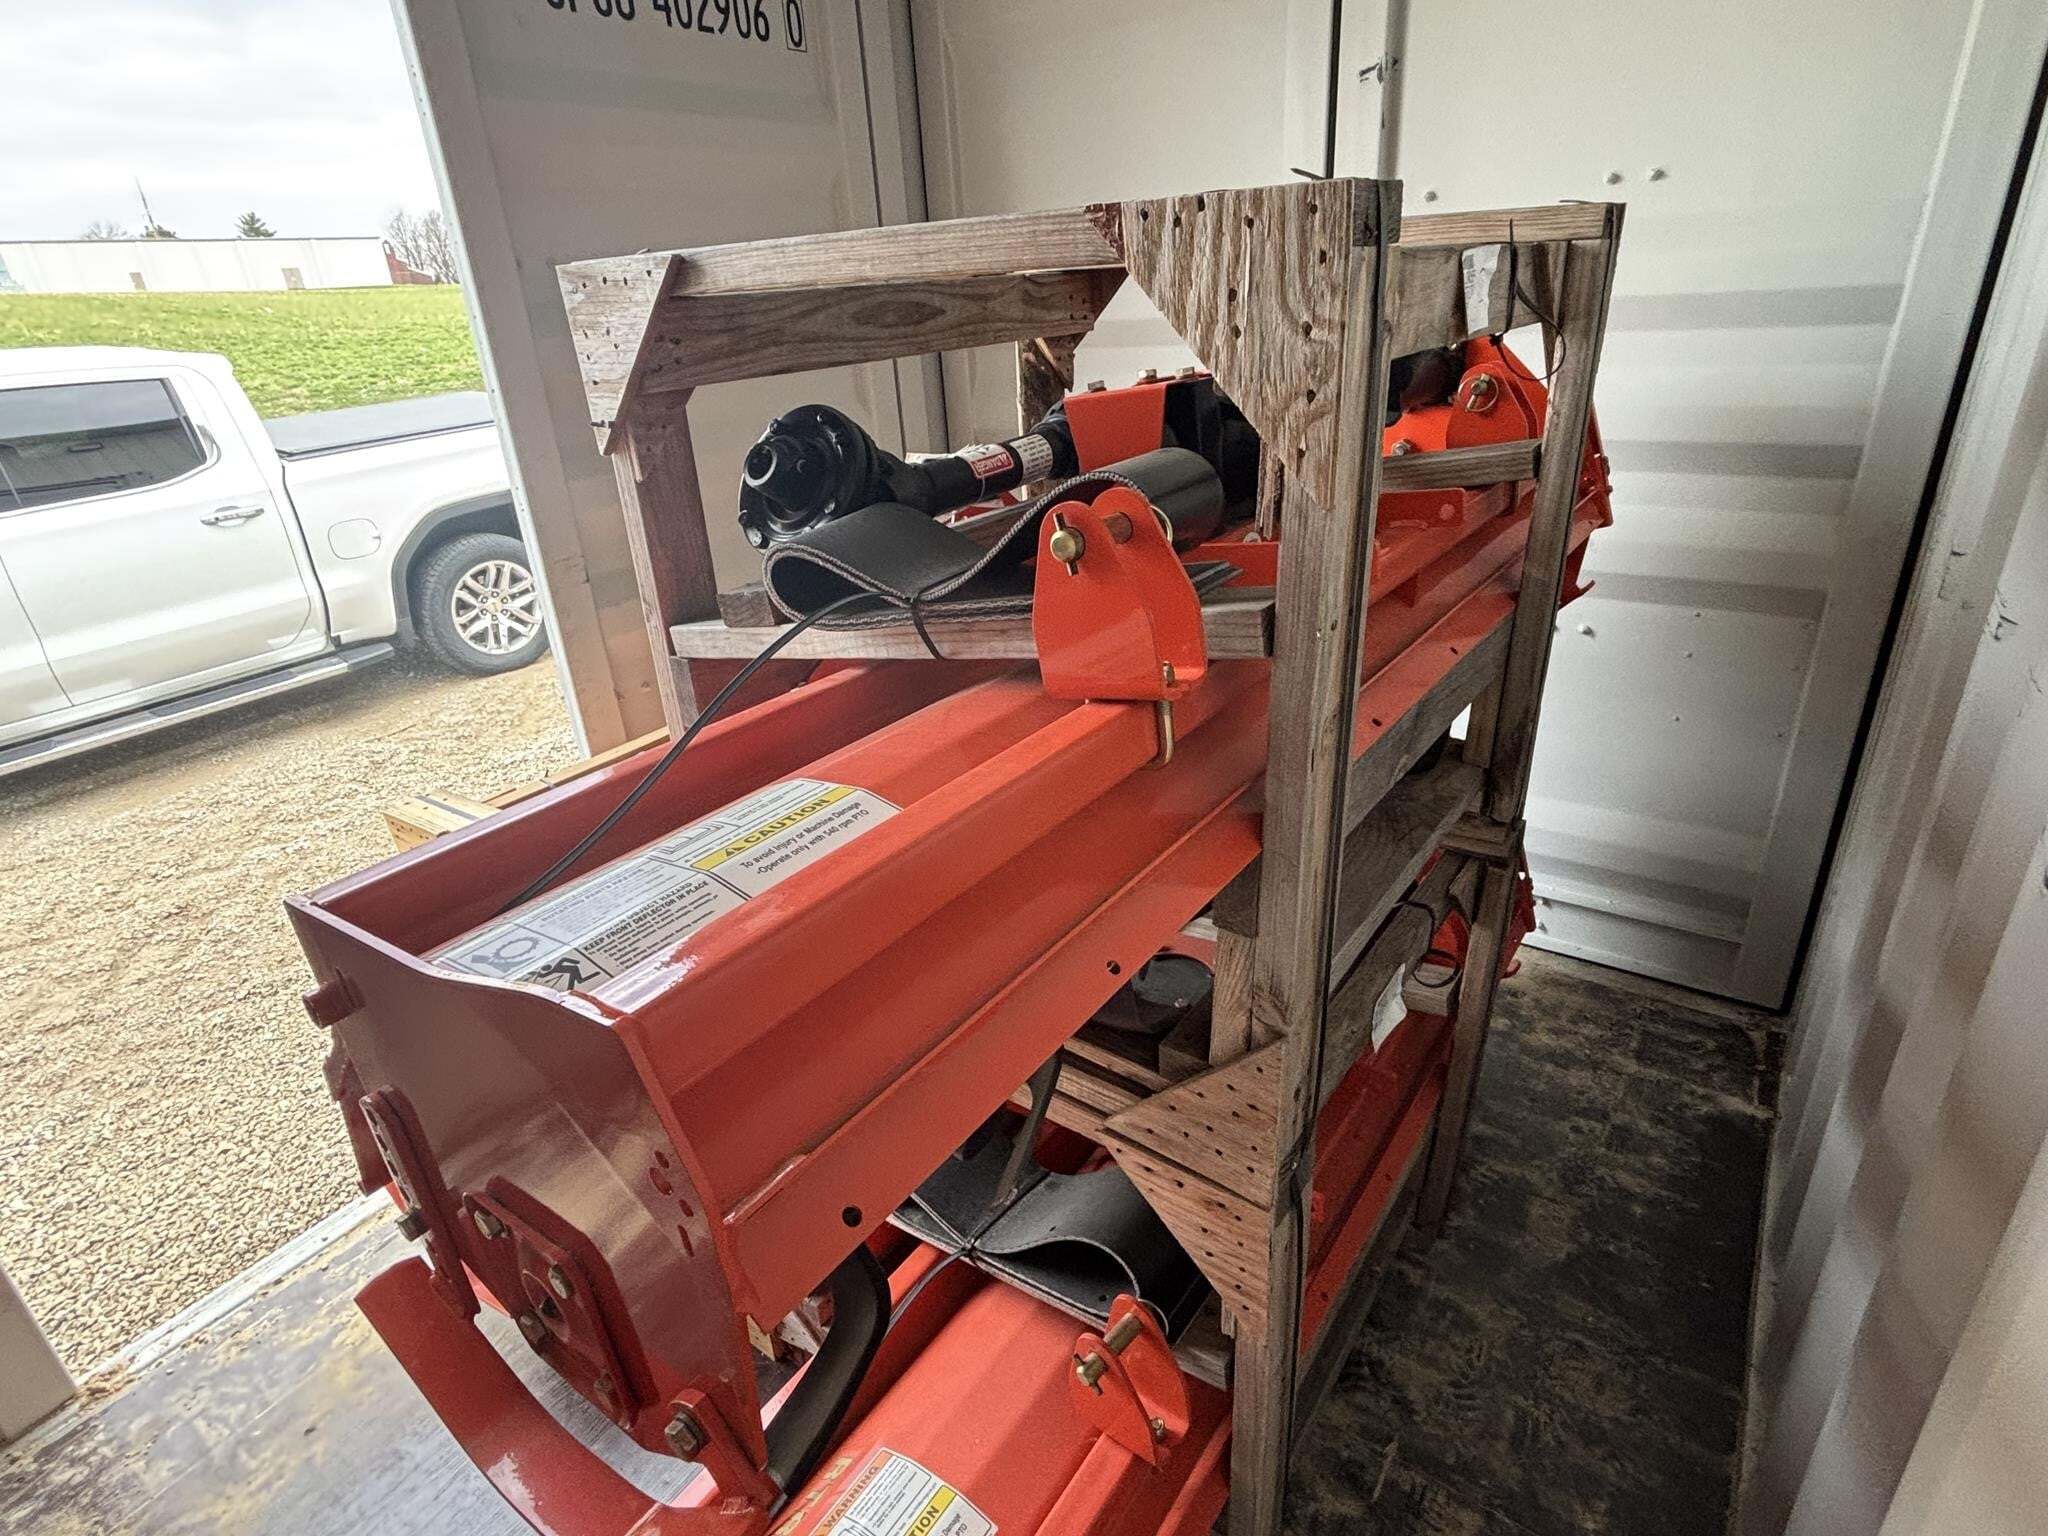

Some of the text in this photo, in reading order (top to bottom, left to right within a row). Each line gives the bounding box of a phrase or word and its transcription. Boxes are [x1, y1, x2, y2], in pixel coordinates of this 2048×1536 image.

[653, 0, 770, 42] 402906
[740, 860, 754, 869] To
[753, 847, 776, 863] avoid
[796, 832, 806, 841] or
[803, 814, 834, 834] Machine
[832, 801, 862, 819] Damage
[743, 798, 831, 844] CAUTION
[790, 842, 811, 858] only
[809, 834, 826, 848] with
[838, 817, 855, 830] rpm
[851, 808, 870, 821] PTO
[583, 938, 605, 952] KEEP
[605, 922, 633, 940] FRONT
[632, 898, 677, 925] DEFLECTOR
[685, 880, 709, 897] PLACE
[823, 1466, 880, 1528] WARNING
